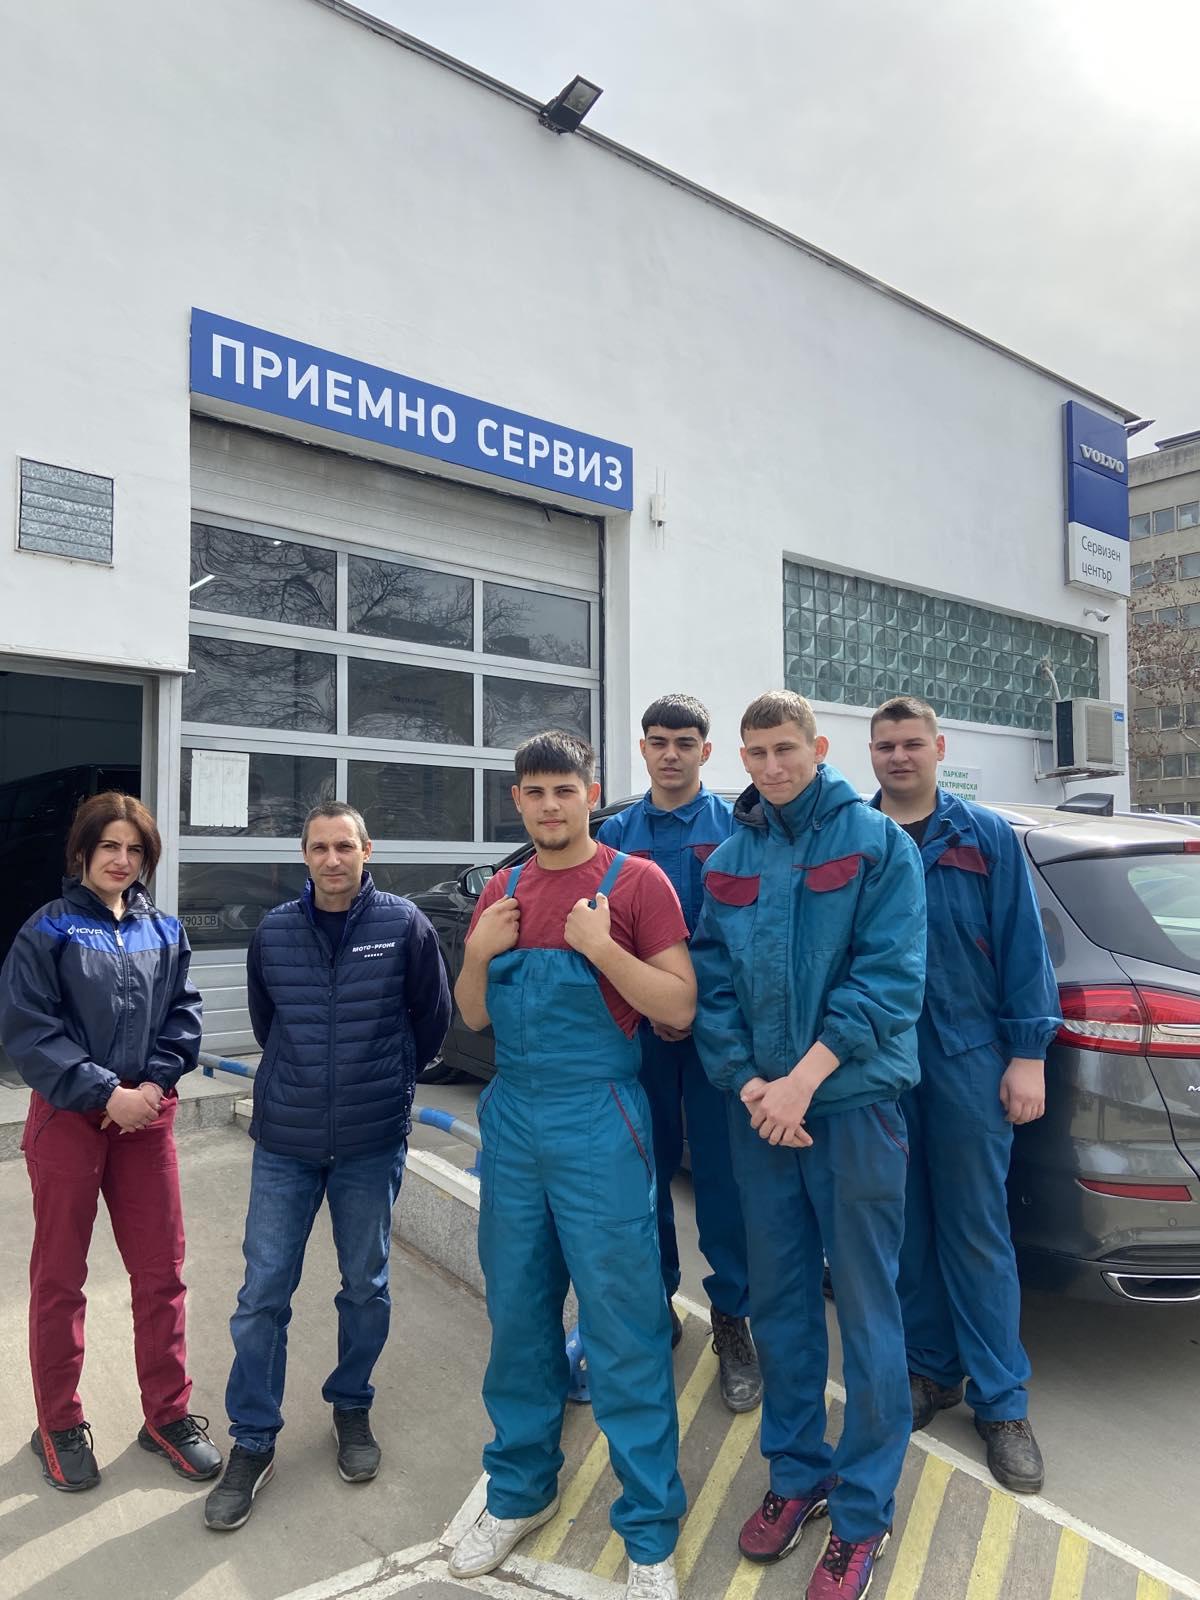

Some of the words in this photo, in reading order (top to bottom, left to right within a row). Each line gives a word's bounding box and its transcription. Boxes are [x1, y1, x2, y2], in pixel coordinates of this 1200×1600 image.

[212, 333, 457, 444] ПРИЕМНО
[477, 418, 623, 492] СЕРВИЗ
[1080, 443, 1125, 474] VOLVO
[1081, 535, 1121, 562] Сервизен
[1081, 561, 1113, 583] център
[937, 780, 978, 791] ЛЕКТРИЧЕСКИ
[943, 770, 969, 779] ПАРКИНГ
